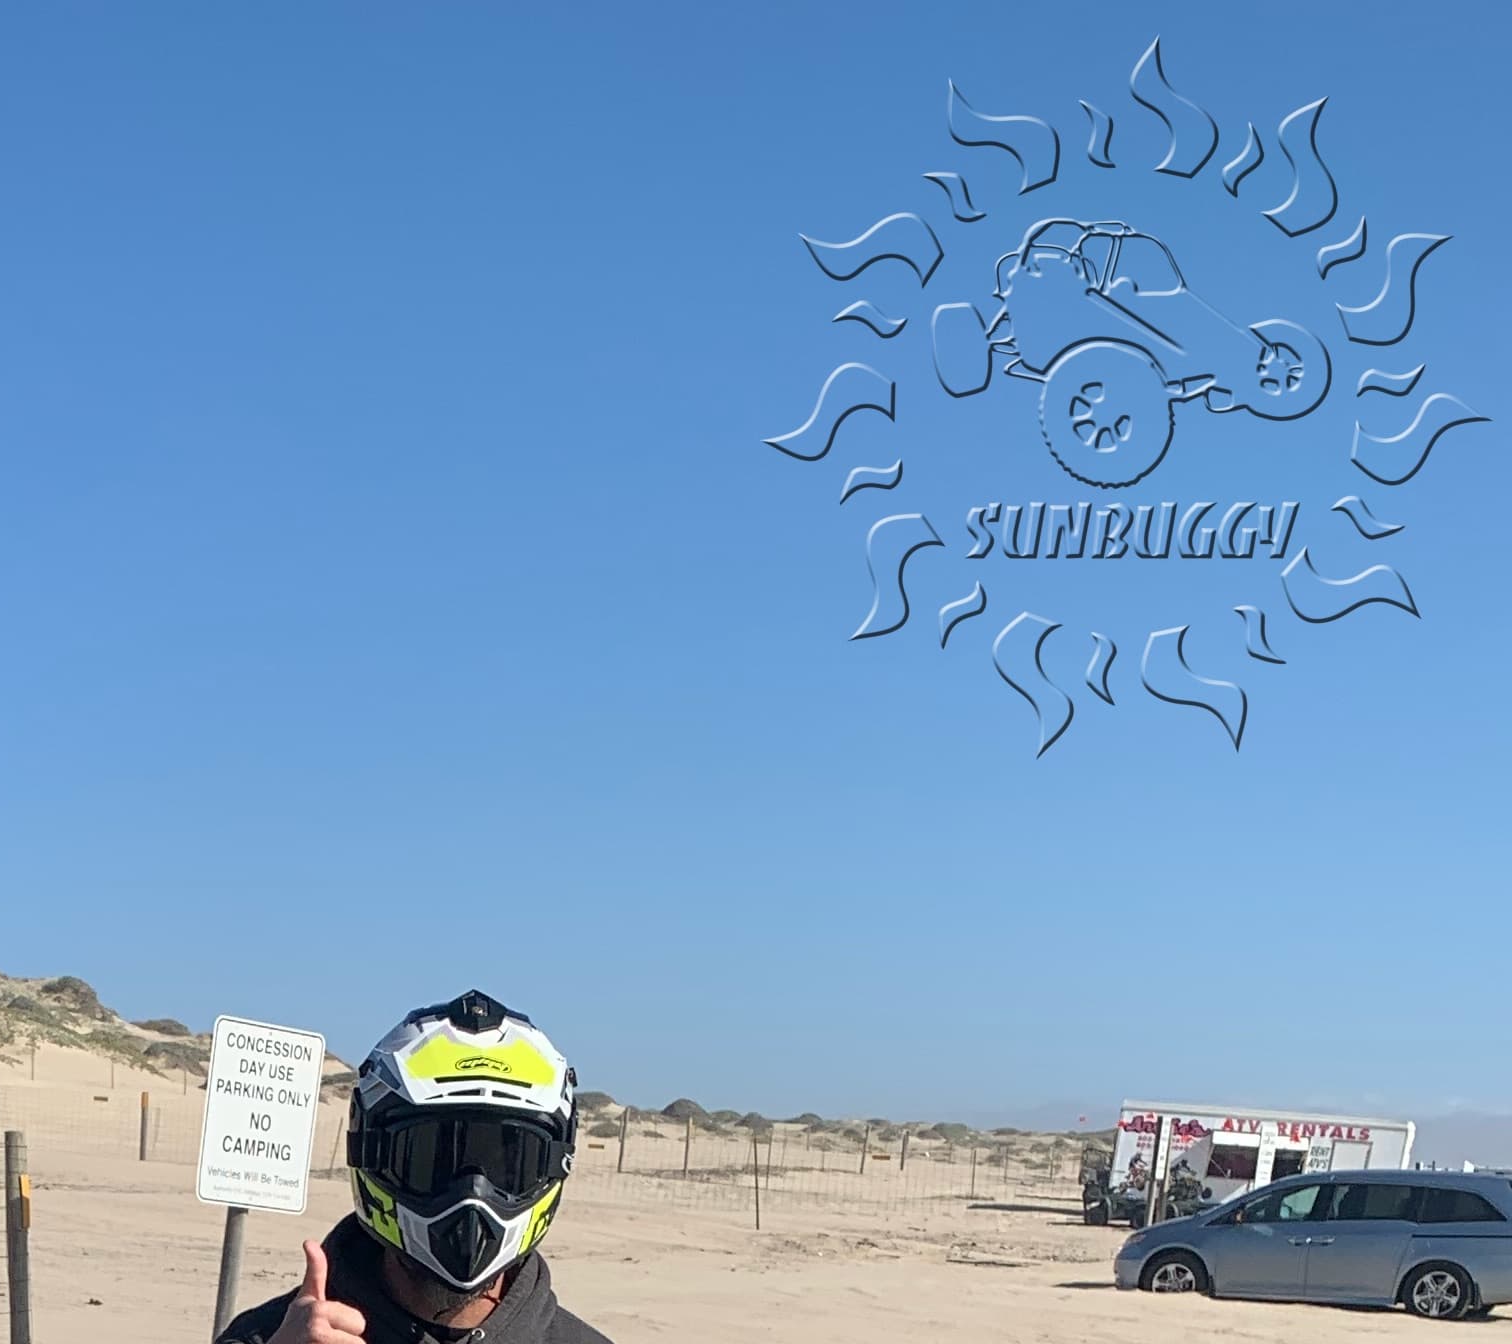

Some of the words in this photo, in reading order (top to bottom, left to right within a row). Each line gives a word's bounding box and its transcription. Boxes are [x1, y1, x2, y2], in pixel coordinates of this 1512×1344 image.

[226, 1032, 312, 1062] CONCESSION
[239, 1058, 265, 1076] DAY
[268, 1063, 295, 1082] USE
[216, 1078, 274, 1102] PARKING
[277, 1088, 311, 1108] ONLY
[249, 1112, 272, 1132] NO
[1222, 1117, 1260, 1133] ATV
[1277, 1121, 1371, 1141] RENTALS
[222, 1135, 292, 1161] CAMPING
[207, 1166, 241, 1181] Vehicles
[260, 1174, 272, 1185] Be
[273, 1175, 300, 1189] Towed
